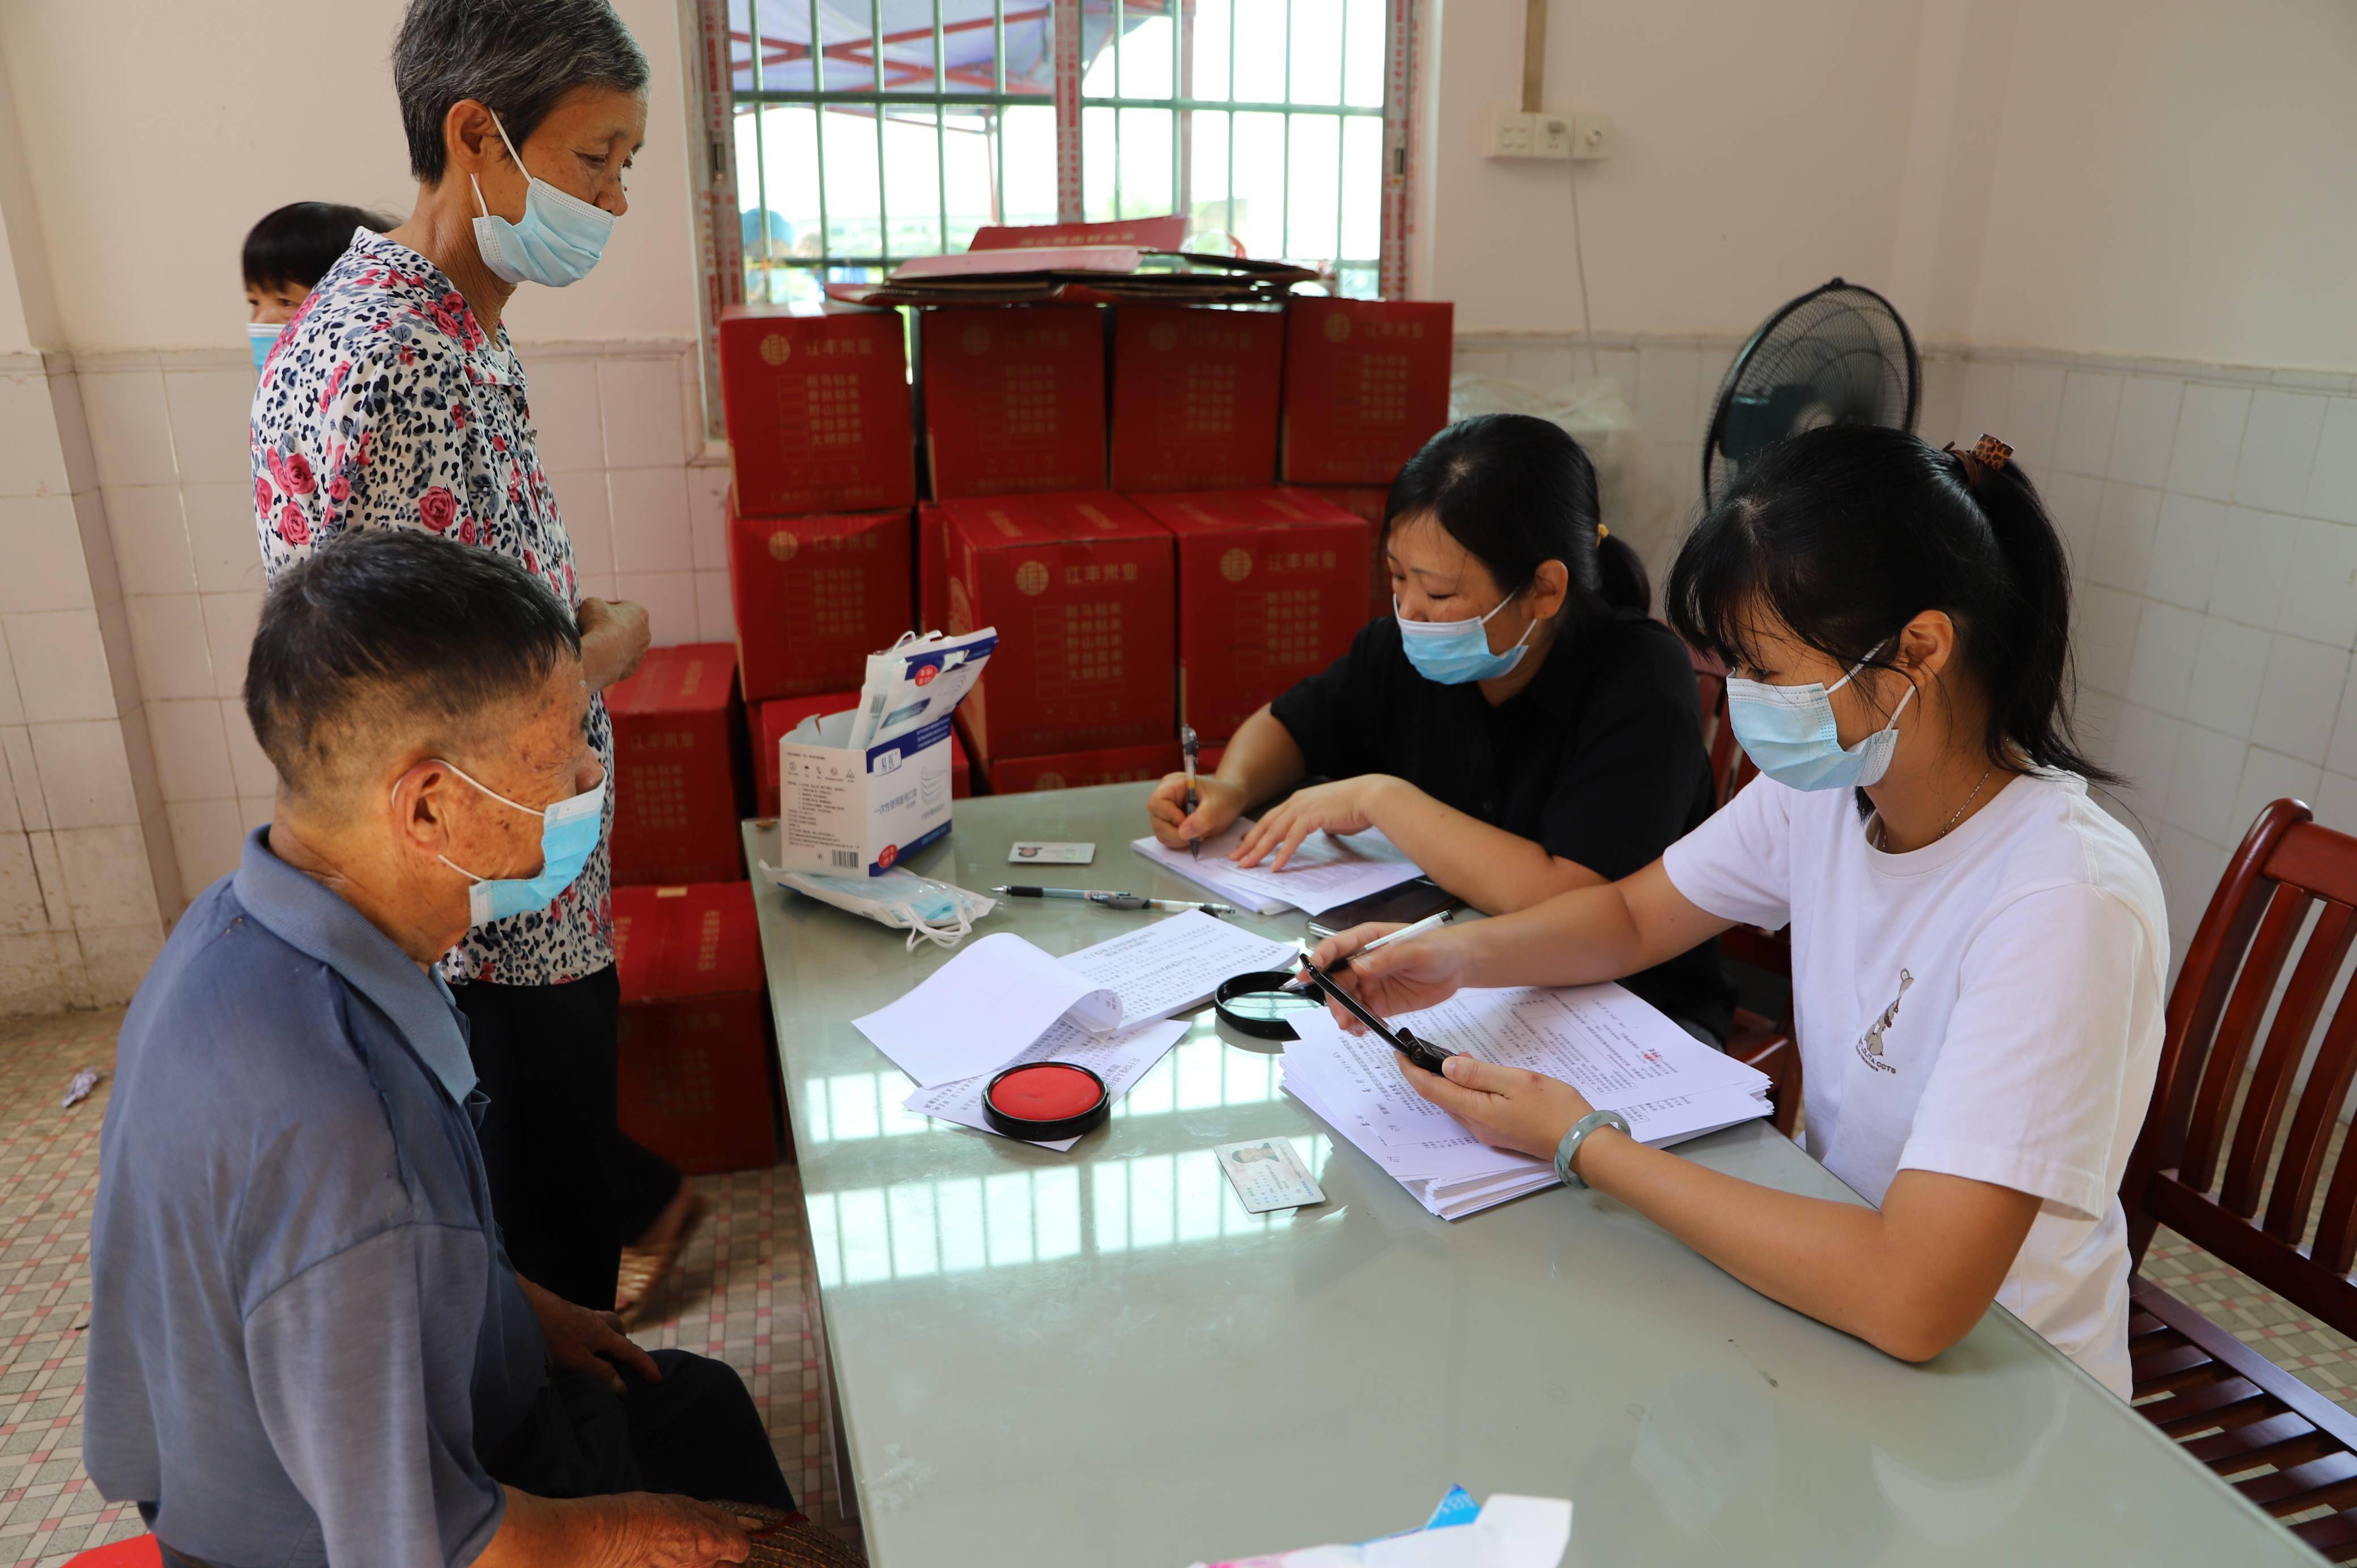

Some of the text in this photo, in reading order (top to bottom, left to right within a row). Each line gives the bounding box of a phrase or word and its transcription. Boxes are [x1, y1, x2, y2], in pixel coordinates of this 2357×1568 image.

[1064, 563, 1138, 585] 江丰米业
[1861, 1046, 1875, 1064] LOLITA
[1877, 1062, 1896, 1073] CCTS
